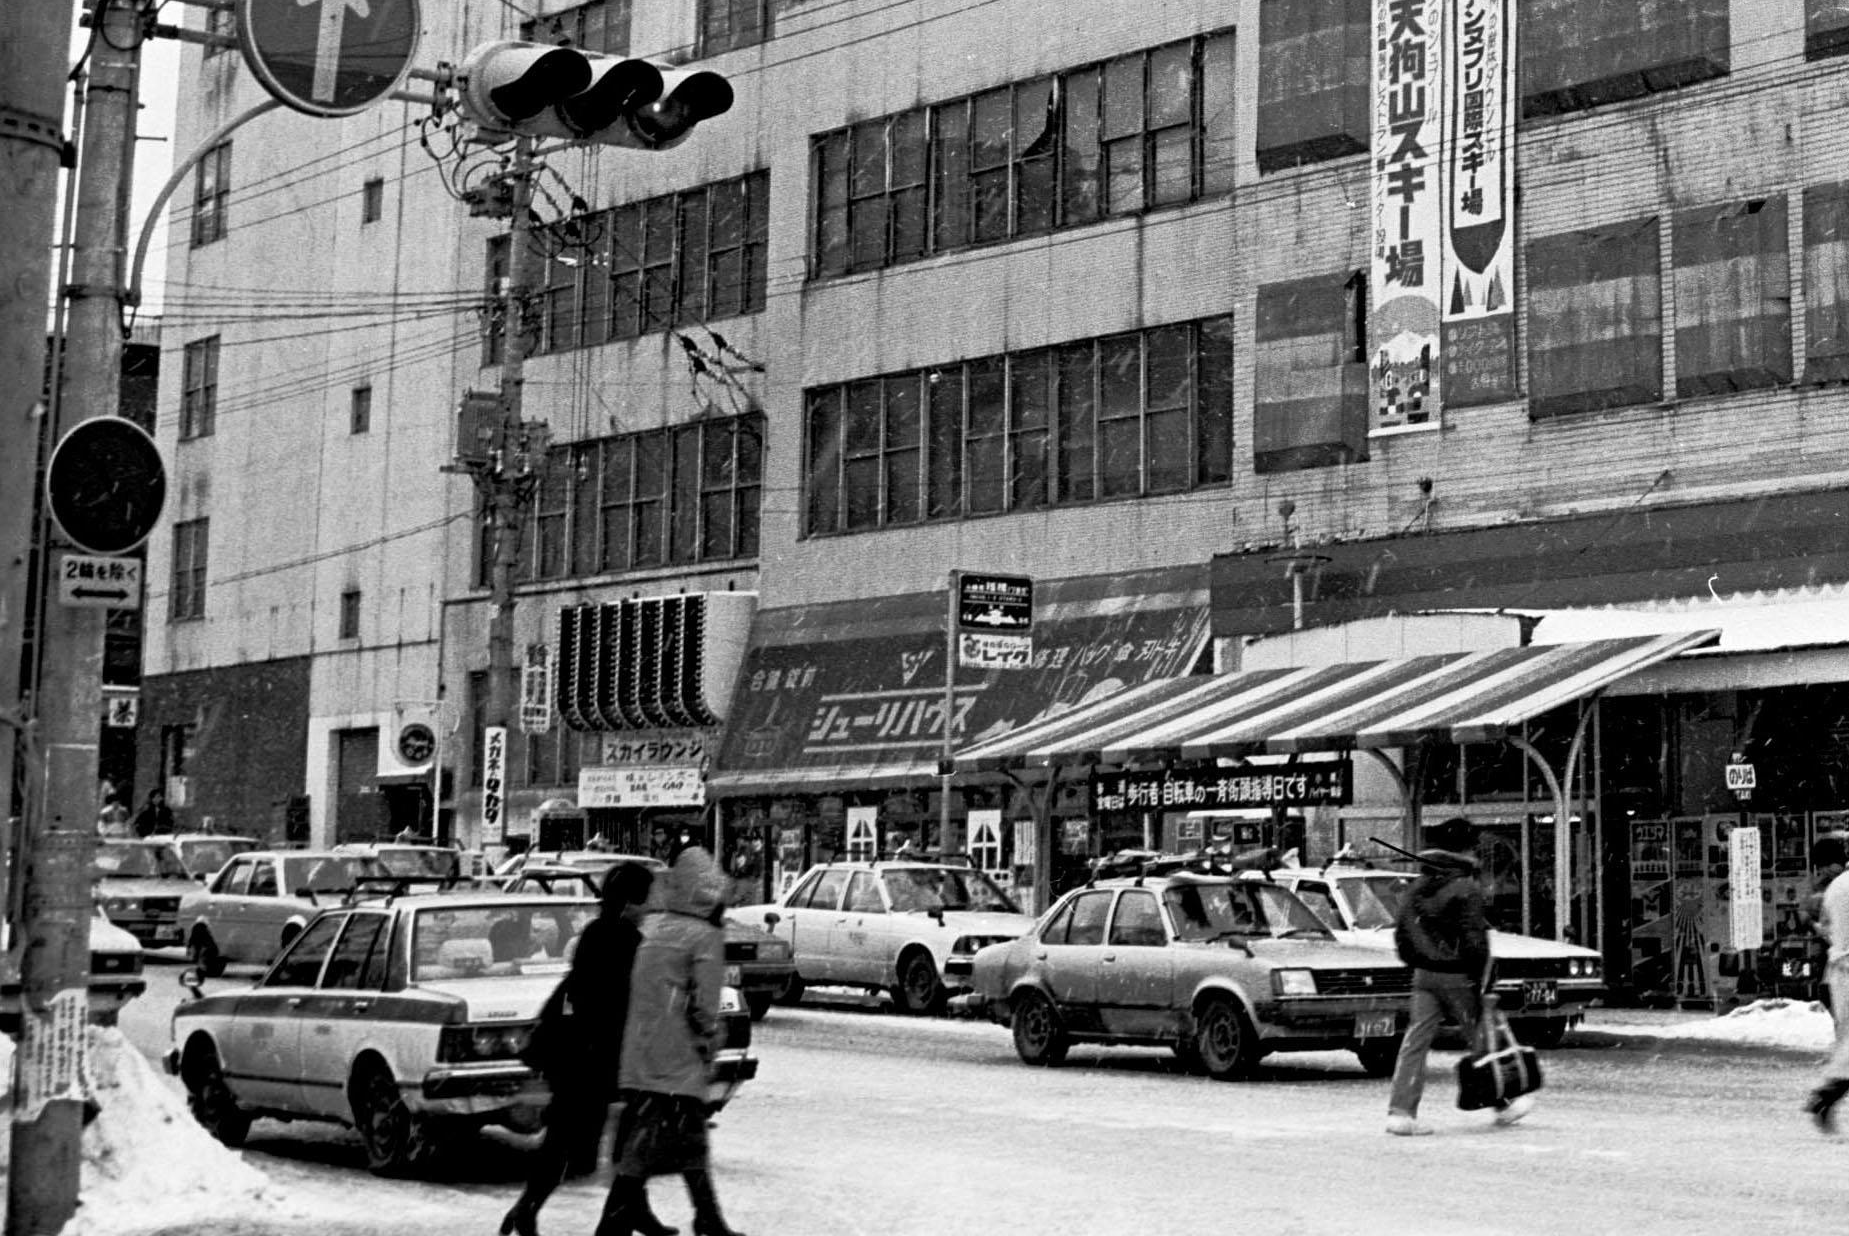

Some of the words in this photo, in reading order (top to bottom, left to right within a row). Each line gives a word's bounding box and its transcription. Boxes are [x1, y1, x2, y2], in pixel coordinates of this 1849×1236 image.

[67, 560, 137, 580] 2輪を除く
[982, 649, 1029, 664] レイク
[808, 695, 977, 741] シューリハウス
